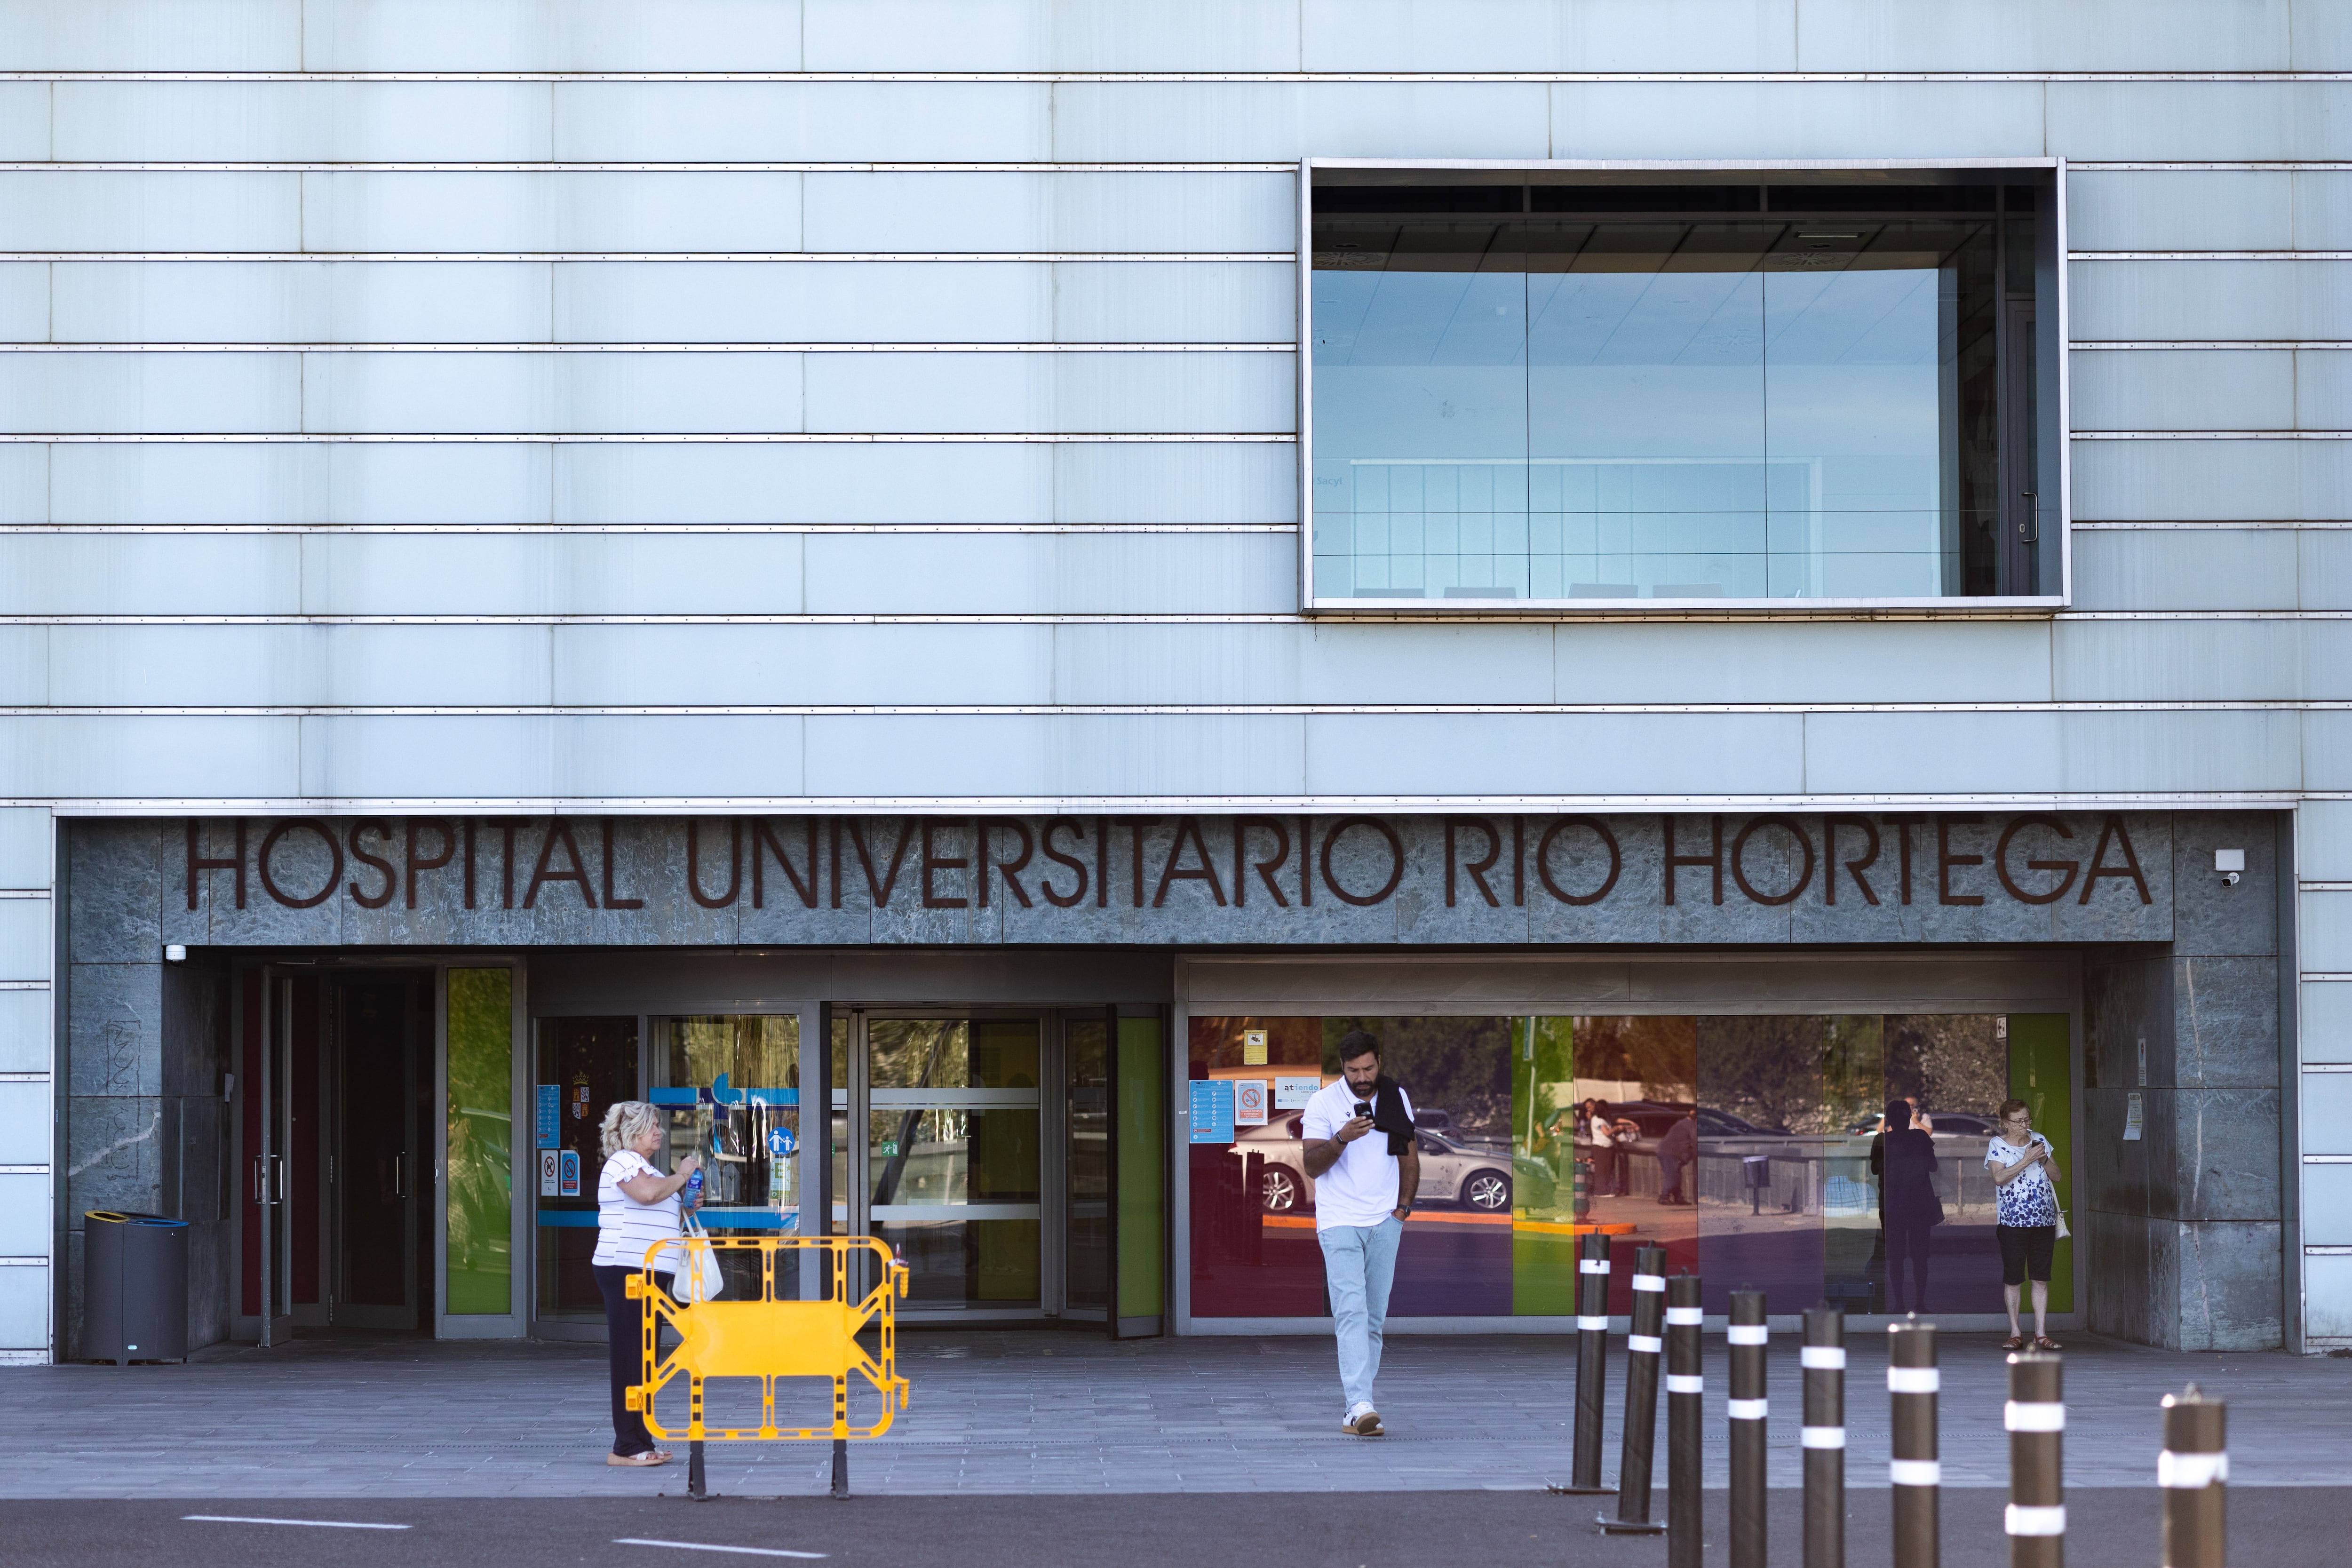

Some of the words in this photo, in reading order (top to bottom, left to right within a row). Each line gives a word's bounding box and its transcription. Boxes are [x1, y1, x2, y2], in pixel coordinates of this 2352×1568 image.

[1317, 477, 1342, 487] Sacyl
[188, 817, 643, 909] HOSPITAL
[688, 816, 1403, 909] UNIVERSITARIO
[1445, 815, 1621, 907] RIO
[1664, 813, 2153, 906] HORTEGA
